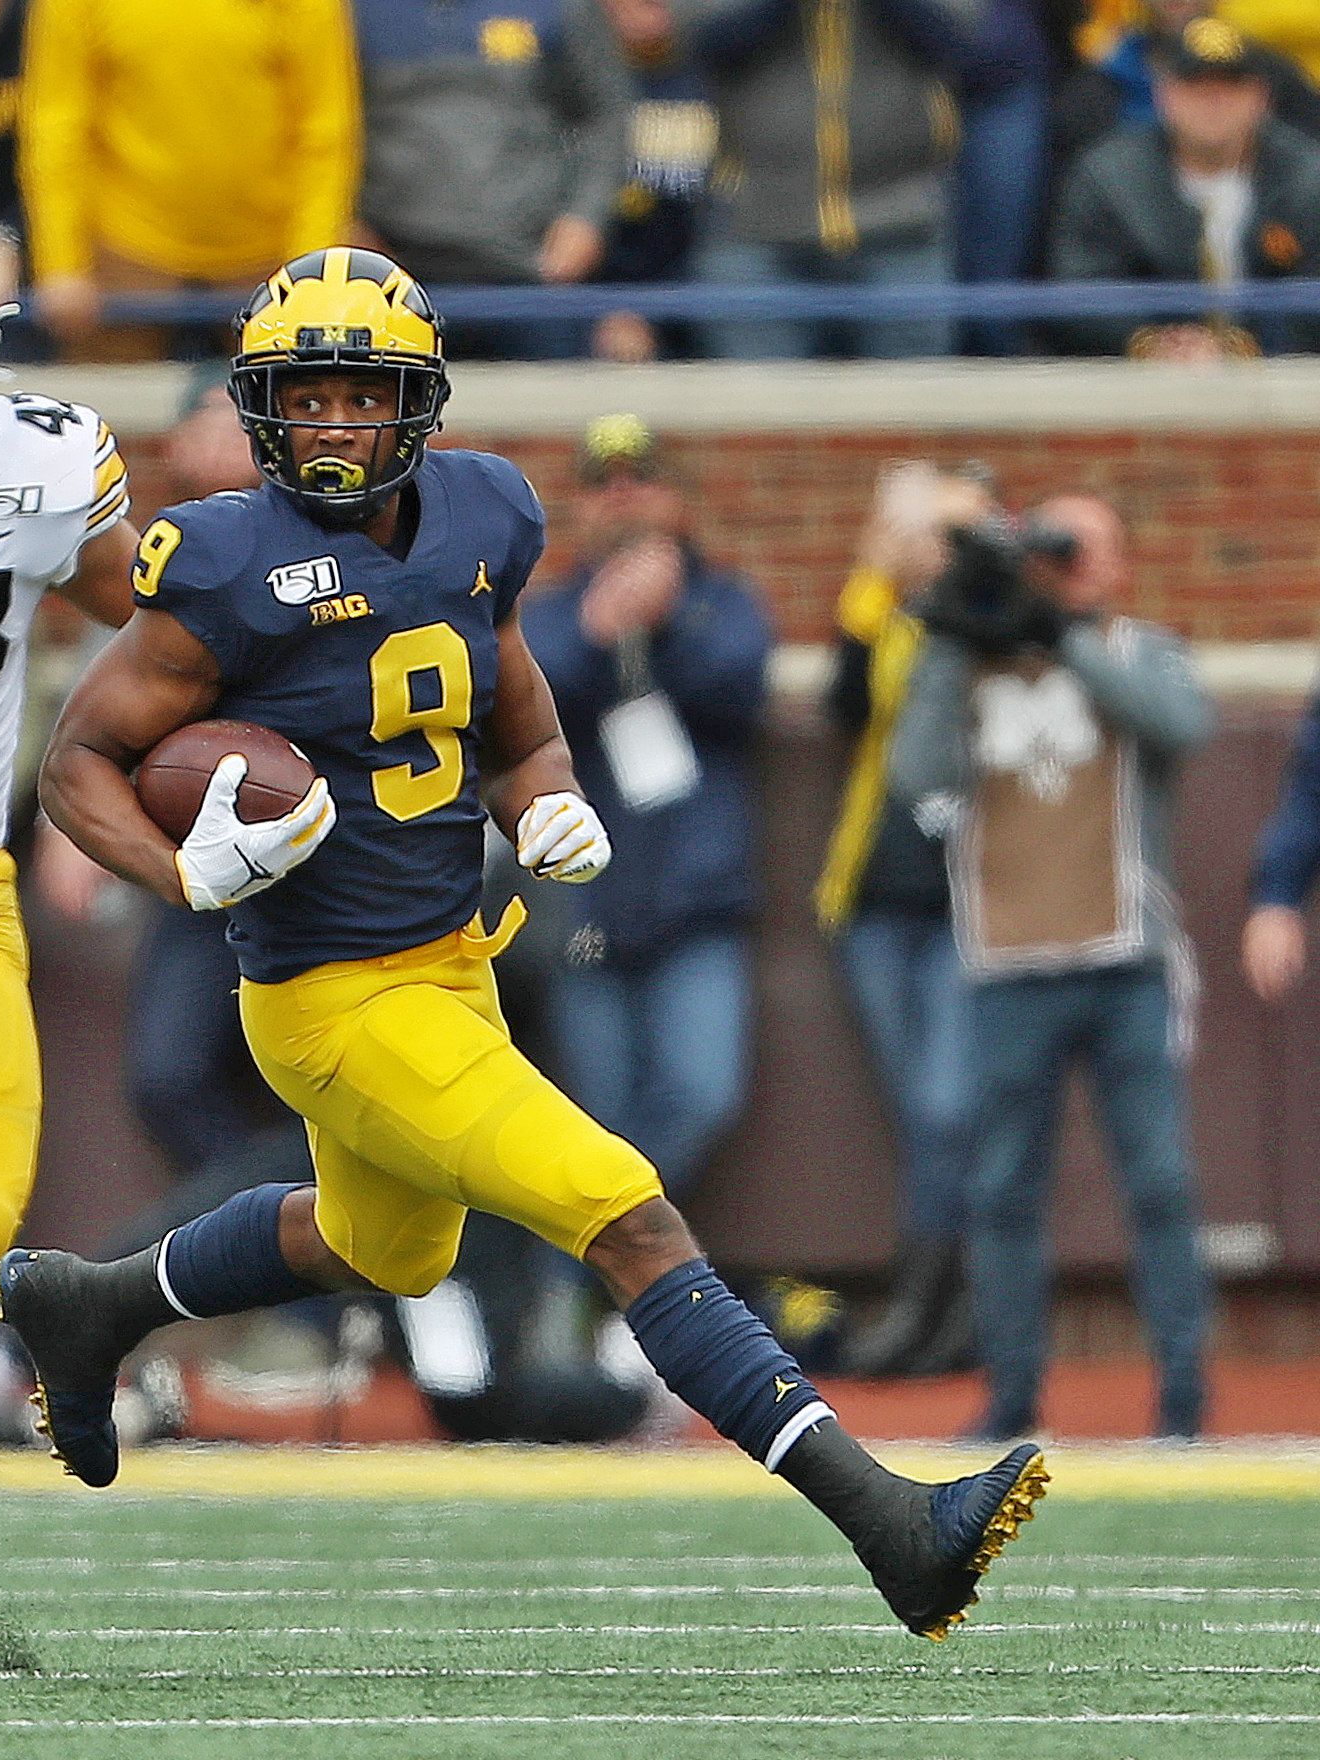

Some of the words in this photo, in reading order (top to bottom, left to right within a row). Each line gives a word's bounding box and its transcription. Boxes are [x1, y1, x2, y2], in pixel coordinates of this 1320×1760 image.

[132, 518, 183, 597] 9
[265, 555, 343, 605] 150
[368, 620, 473, 822] 9
